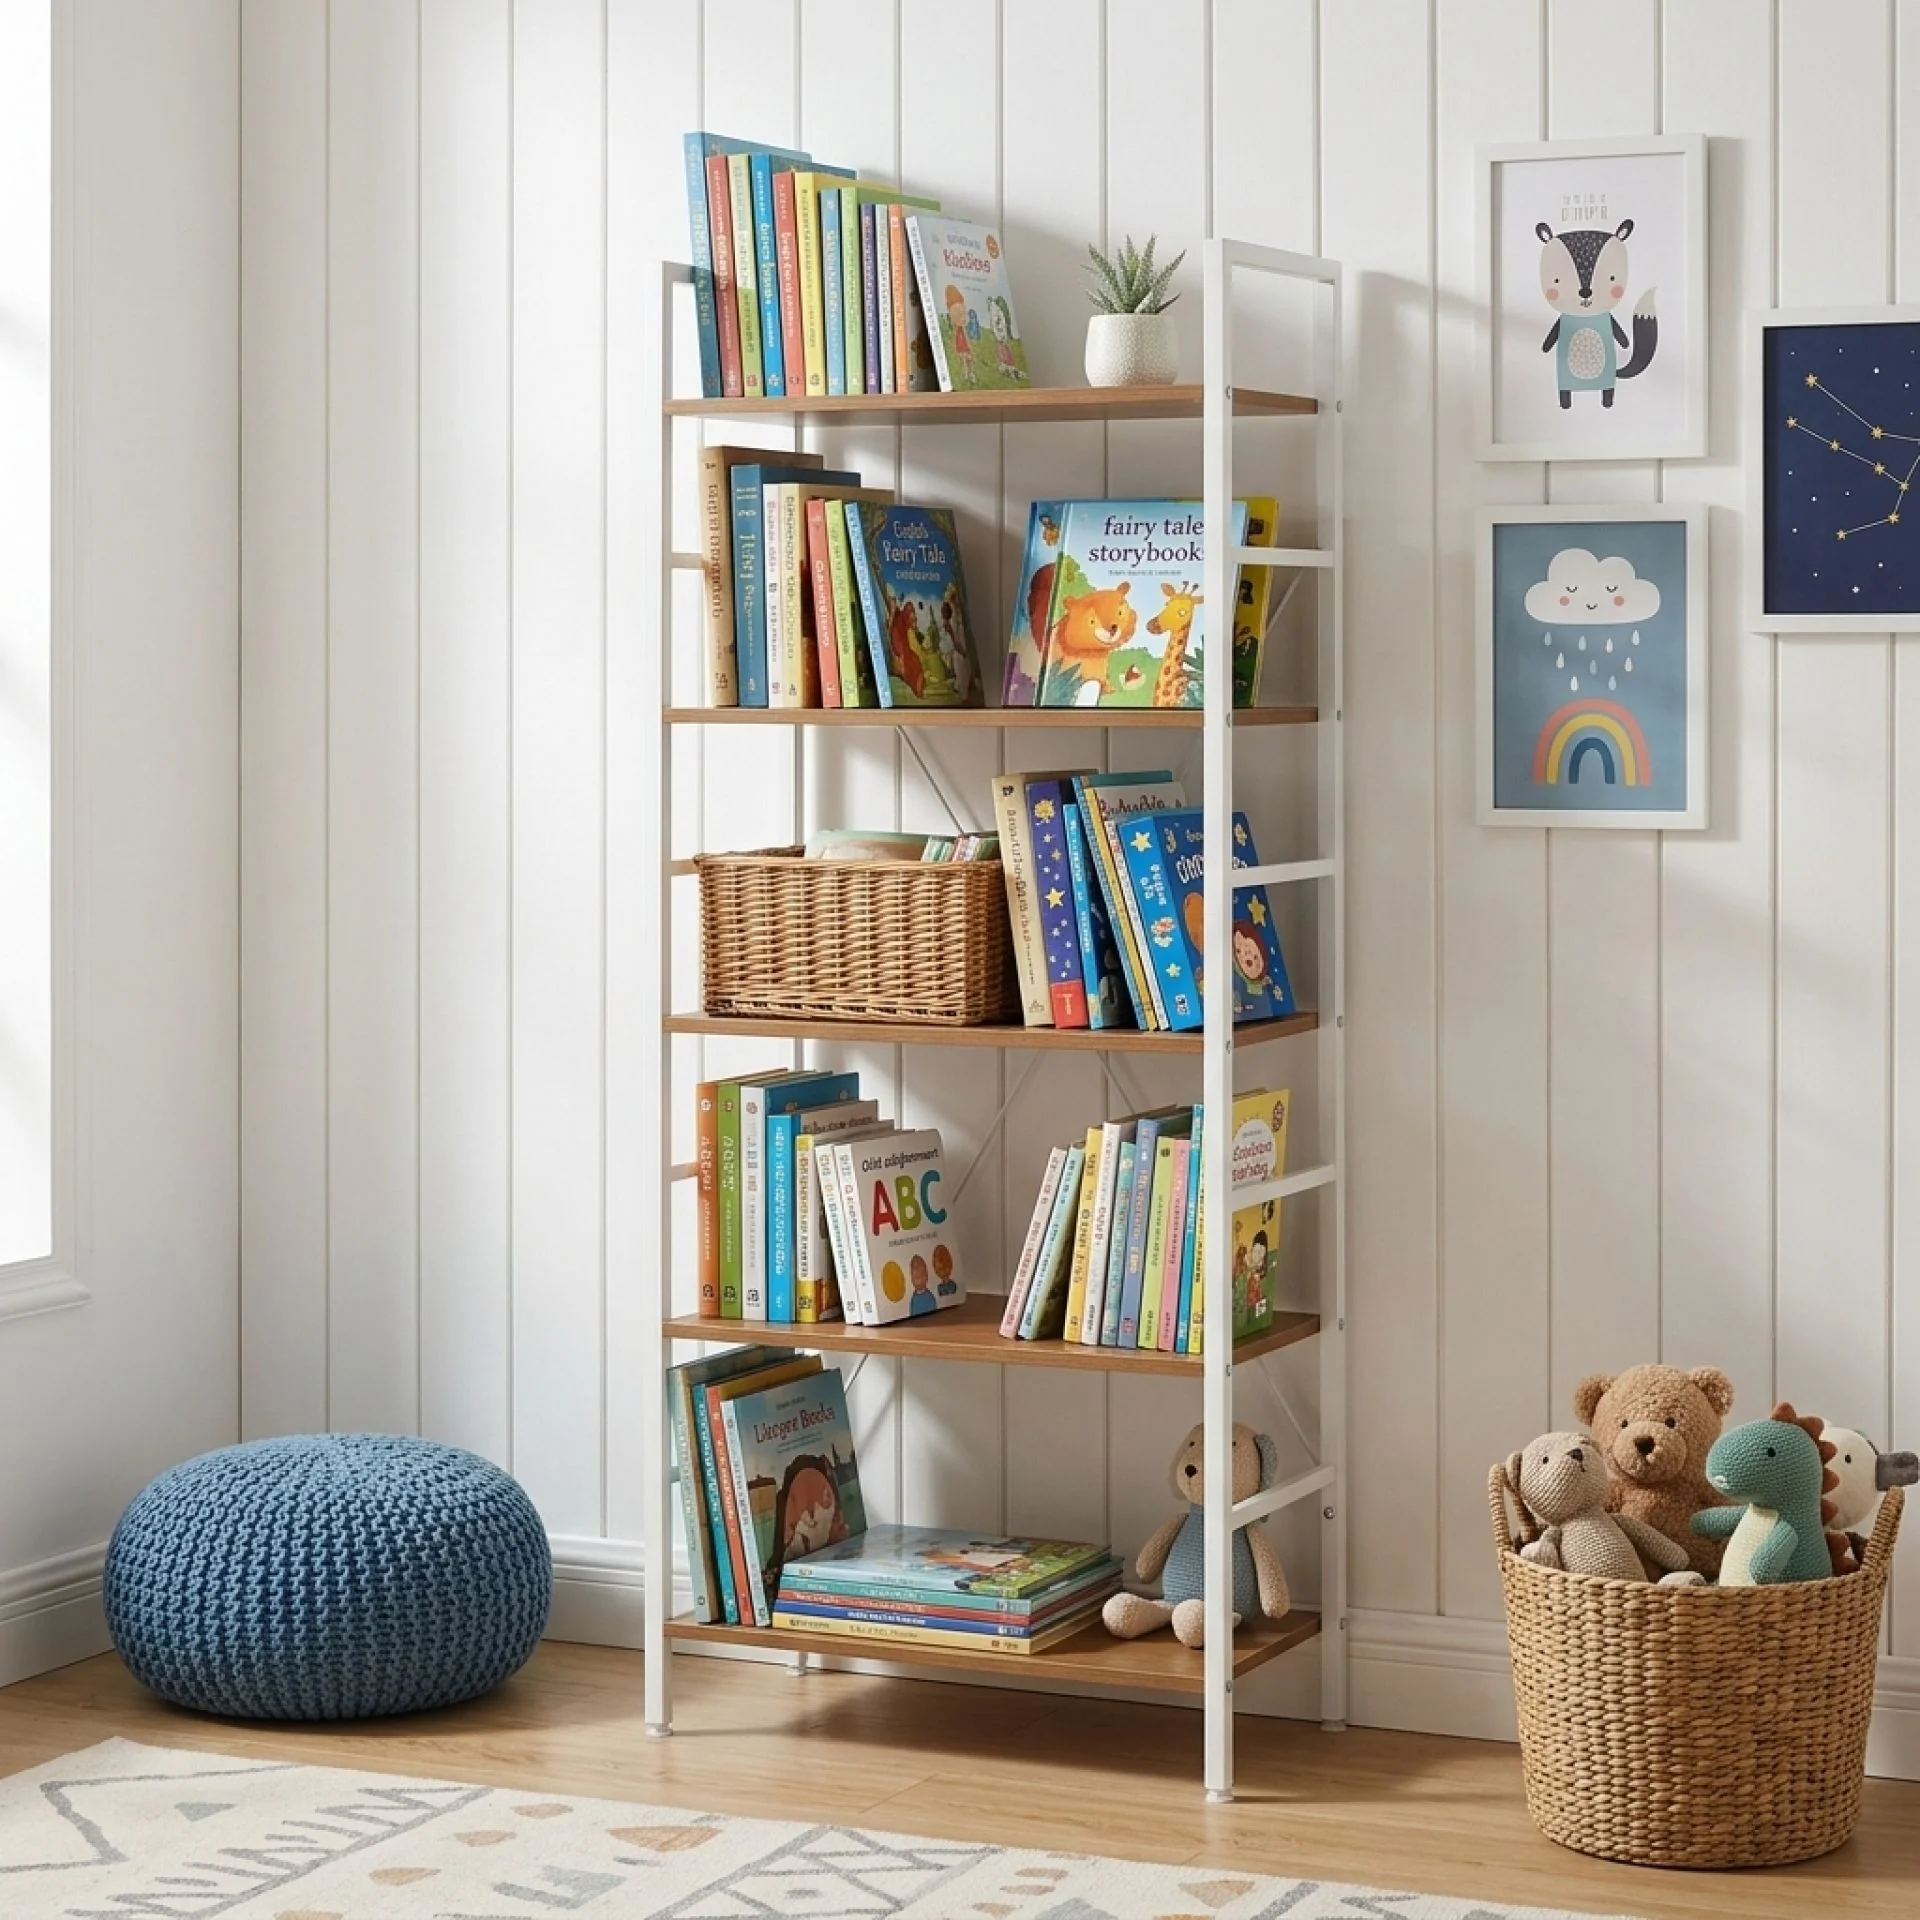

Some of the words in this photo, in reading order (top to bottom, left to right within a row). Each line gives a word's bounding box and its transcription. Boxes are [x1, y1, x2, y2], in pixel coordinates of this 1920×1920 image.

[1104, 515, 1157, 541] fairy
[1088, 541, 1204, 568] storybook
[871, 1169, 947, 1236] ABC
